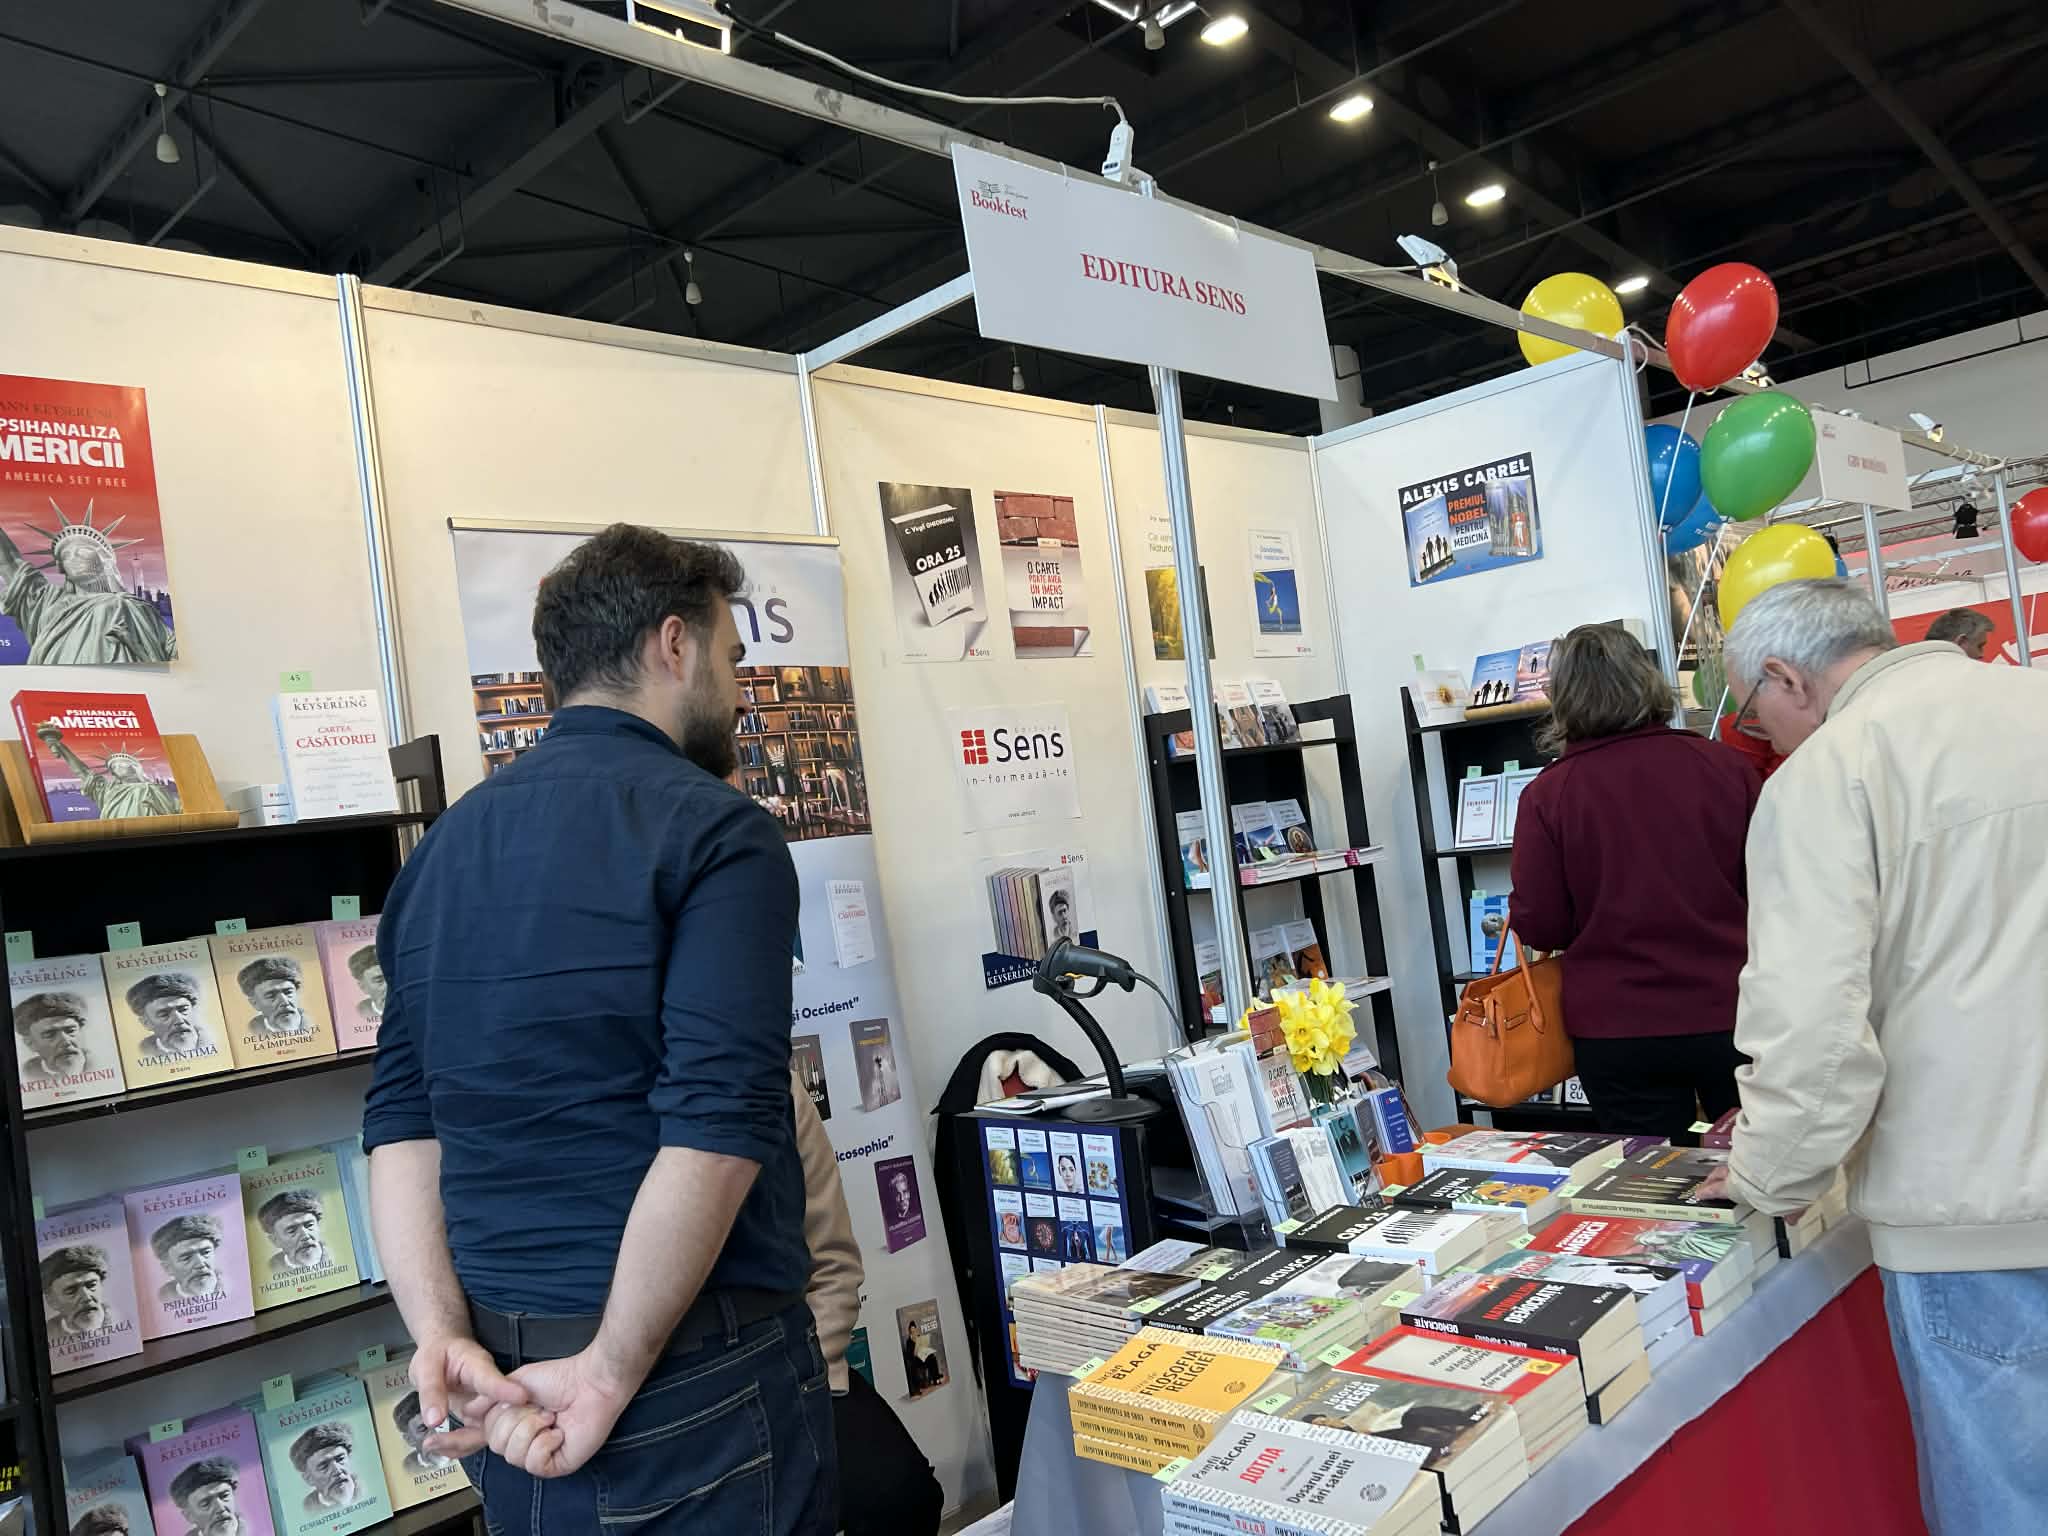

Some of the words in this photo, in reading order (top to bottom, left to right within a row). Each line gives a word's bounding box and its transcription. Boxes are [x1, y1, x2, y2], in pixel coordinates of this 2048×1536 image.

[970, 189, 1029, 220] Bookfest
[1080, 252, 1193, 300] EDITURA
[1195, 280, 1247, 316] SENS
[0, 418, 121, 440] PSIHANALIZA
[5, 471, 64, 485] AMERICA
[69, 475, 91, 486] SET
[97, 477, 128, 488] FREE
[1402, 478, 1460, 505] ALEXIS
[1463, 458, 1530, 488] CARREL
[1447, 493, 1486, 512] PREMIUL
[1449, 507, 1489, 526] NOBEL
[1455, 519, 1484, 536] PENTRU
[915, 553, 945, 572] ORA
[946, 544, 961, 559] 25
[1027, 563, 1034, 574] O
[1035, 561, 1061, 575] CARTE
[1042, 584, 1063, 596] IMENS
[1031, 596, 1065, 610] IMPACT
[289, 674, 301, 682] 45
[293, 699, 368, 712] KEYSERLING
[50, 716, 140, 729] AMERICII
[295, 733, 377, 750] CĂSĂTORIEI
[993, 728, 1064, 763] Sens
[1066, 854, 1084, 864] Sens
[117, 926, 131, 935] 45
[225, 923, 237, 931] 45
[7, 935, 21, 944] 45
[229, 937, 304, 954] KEYSERLING
[116, 950, 200, 970] KEYSERLING
[987, 966, 1039, 986] KEYSERLING
[250, 1166, 325, 1191] KEYSERLING
[1429, 1177, 1472, 1199] ULTIMA
[143, 1189, 227, 1214] KEYSERLING
[1337, 1220, 1369, 1240] ORA
[1369, 1211, 1391, 1226] 25
[1257, 1254, 1320, 1287] BICIUȘCA
[163, 1289, 228, 1312] PSIHANALIZA
[173, 1300, 219, 1319] AMERICII
[1503, 1283, 1566, 1325] DEMOCRAȚIE
[1413, 1317, 1460, 1334] DEMOCRAȚIE
[1111, 1342, 1161, 1381] BLAGA
[1138, 1348, 1202, 1397] FILOSOFIA
[1164, 1350, 1218, 1393] RELIGIEI
[1336, 1382, 1380, 1413] PRESEI
[279, 1396, 352, 1428] KEYSERLING
[161, 1423, 173, 1433] 45
[1214, 1431, 1257, 1473] ȘEICARU
[1191, 1455, 1219, 1480] Pamfil
[1286, 1470, 1325, 1505] Dosarul
[1320, 1449, 1343, 1477] unei
[1308, 1484, 1330, 1506] țări
[1327, 1457, 1356, 1490] satelit
